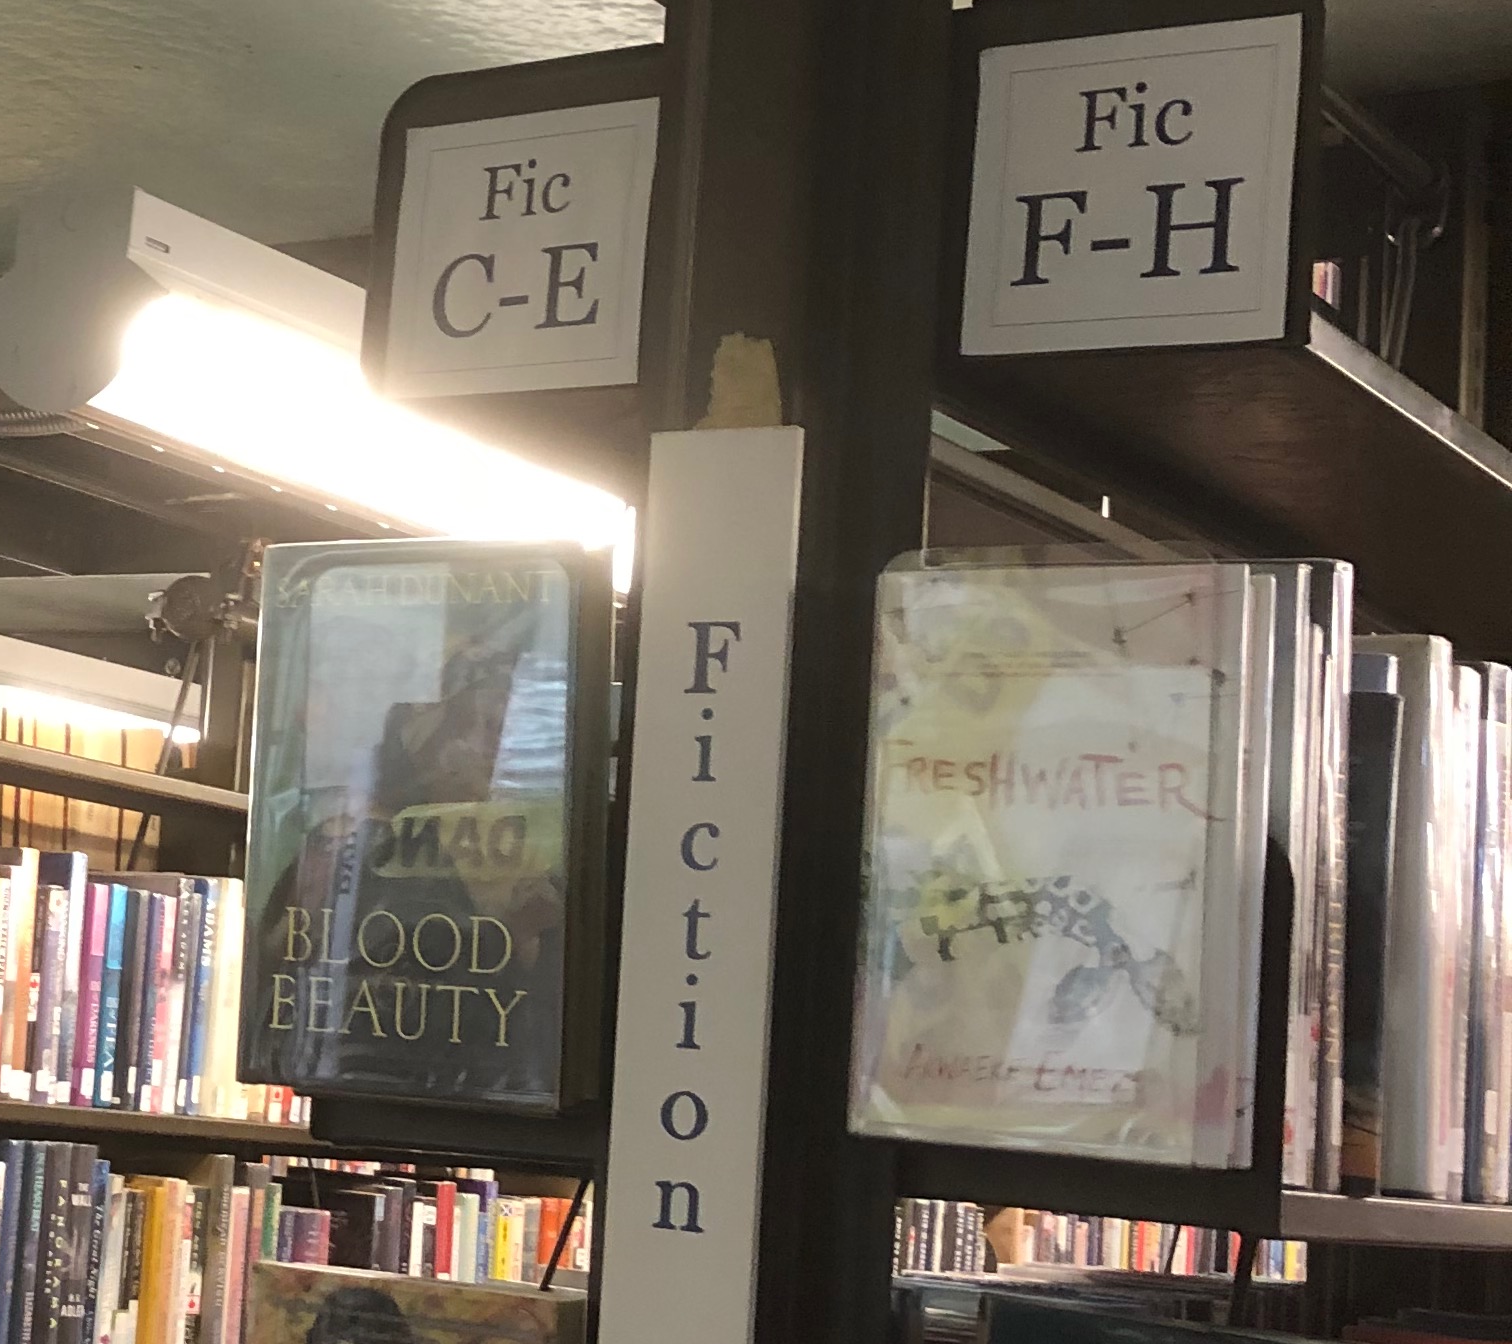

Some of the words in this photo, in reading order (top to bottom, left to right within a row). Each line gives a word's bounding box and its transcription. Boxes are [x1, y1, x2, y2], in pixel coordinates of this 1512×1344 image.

[1074, 83, 1194, 155] Fic
[480, 161, 572, 223] Fic
[1010, 177, 1245, 287] F-H
[432, 242, 600, 339] C-E
[275, 575, 386, 609] SARAH
[393, 570, 552, 607] DUNANT
[881, 752, 1225, 823] FRESHWATER
[201, 898, 217, 968] ADAMS
[283, 905, 513, 974] BLOOD
[652, 620, 742, 1234] Fiction
[268, 974, 528, 1047] BEAUTY
[48, 1179, 68, 1329] PANORAMA
